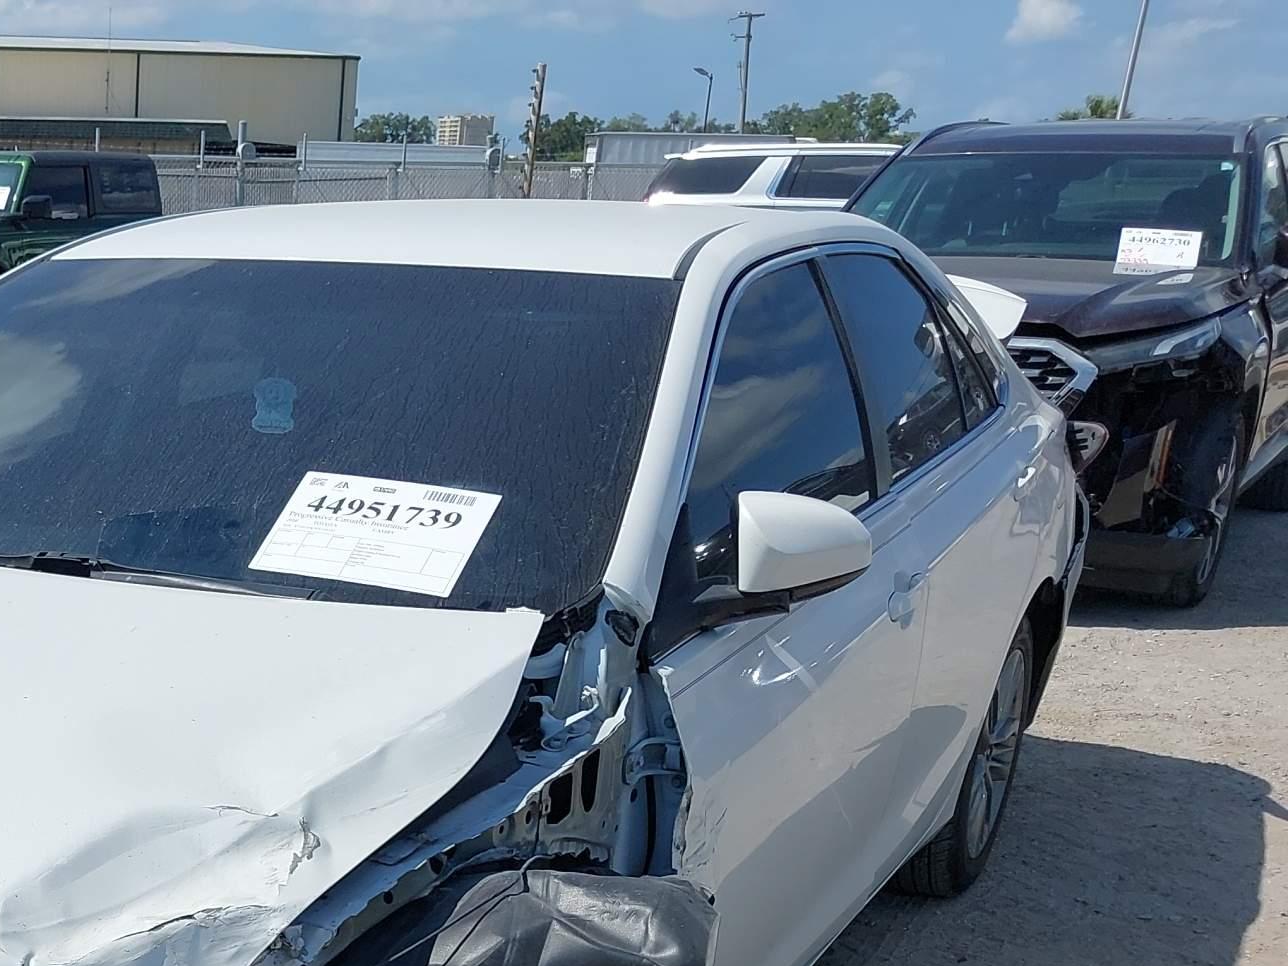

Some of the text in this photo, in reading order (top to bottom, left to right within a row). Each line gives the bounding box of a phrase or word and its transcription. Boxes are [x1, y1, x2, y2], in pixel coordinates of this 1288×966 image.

[1128, 236, 1191, 247] 44962730
[288, 511, 410, 532] Progressive Casualty Insurance
[307, 495, 463, 530] 44951739
